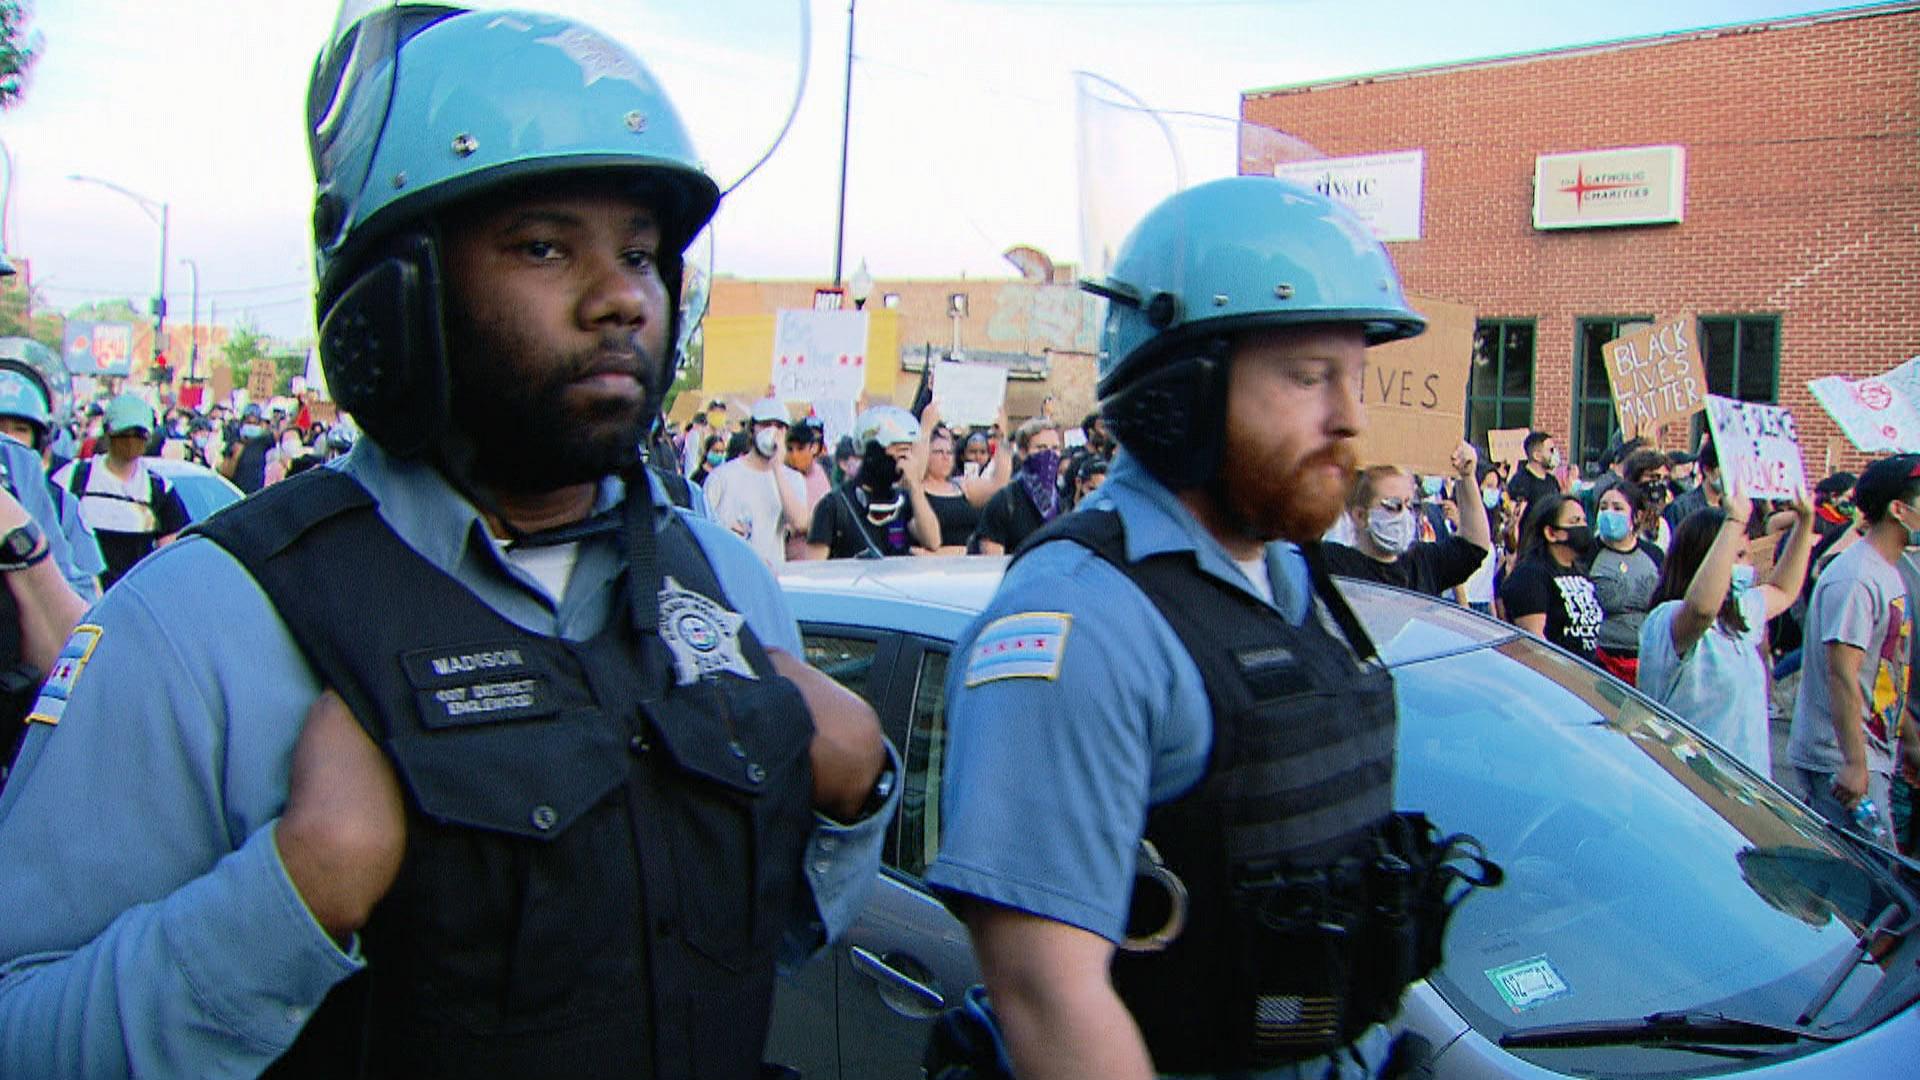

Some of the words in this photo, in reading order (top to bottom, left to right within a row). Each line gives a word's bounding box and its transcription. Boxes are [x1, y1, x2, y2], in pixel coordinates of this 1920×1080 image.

[1613, 320, 1688, 376] BLACK
[1359, 365, 1440, 409] IVES
[1613, 351, 1690, 401] LIVES
[1619, 377, 1699, 434] MATTER
[431, 649, 523, 675] MADISON
